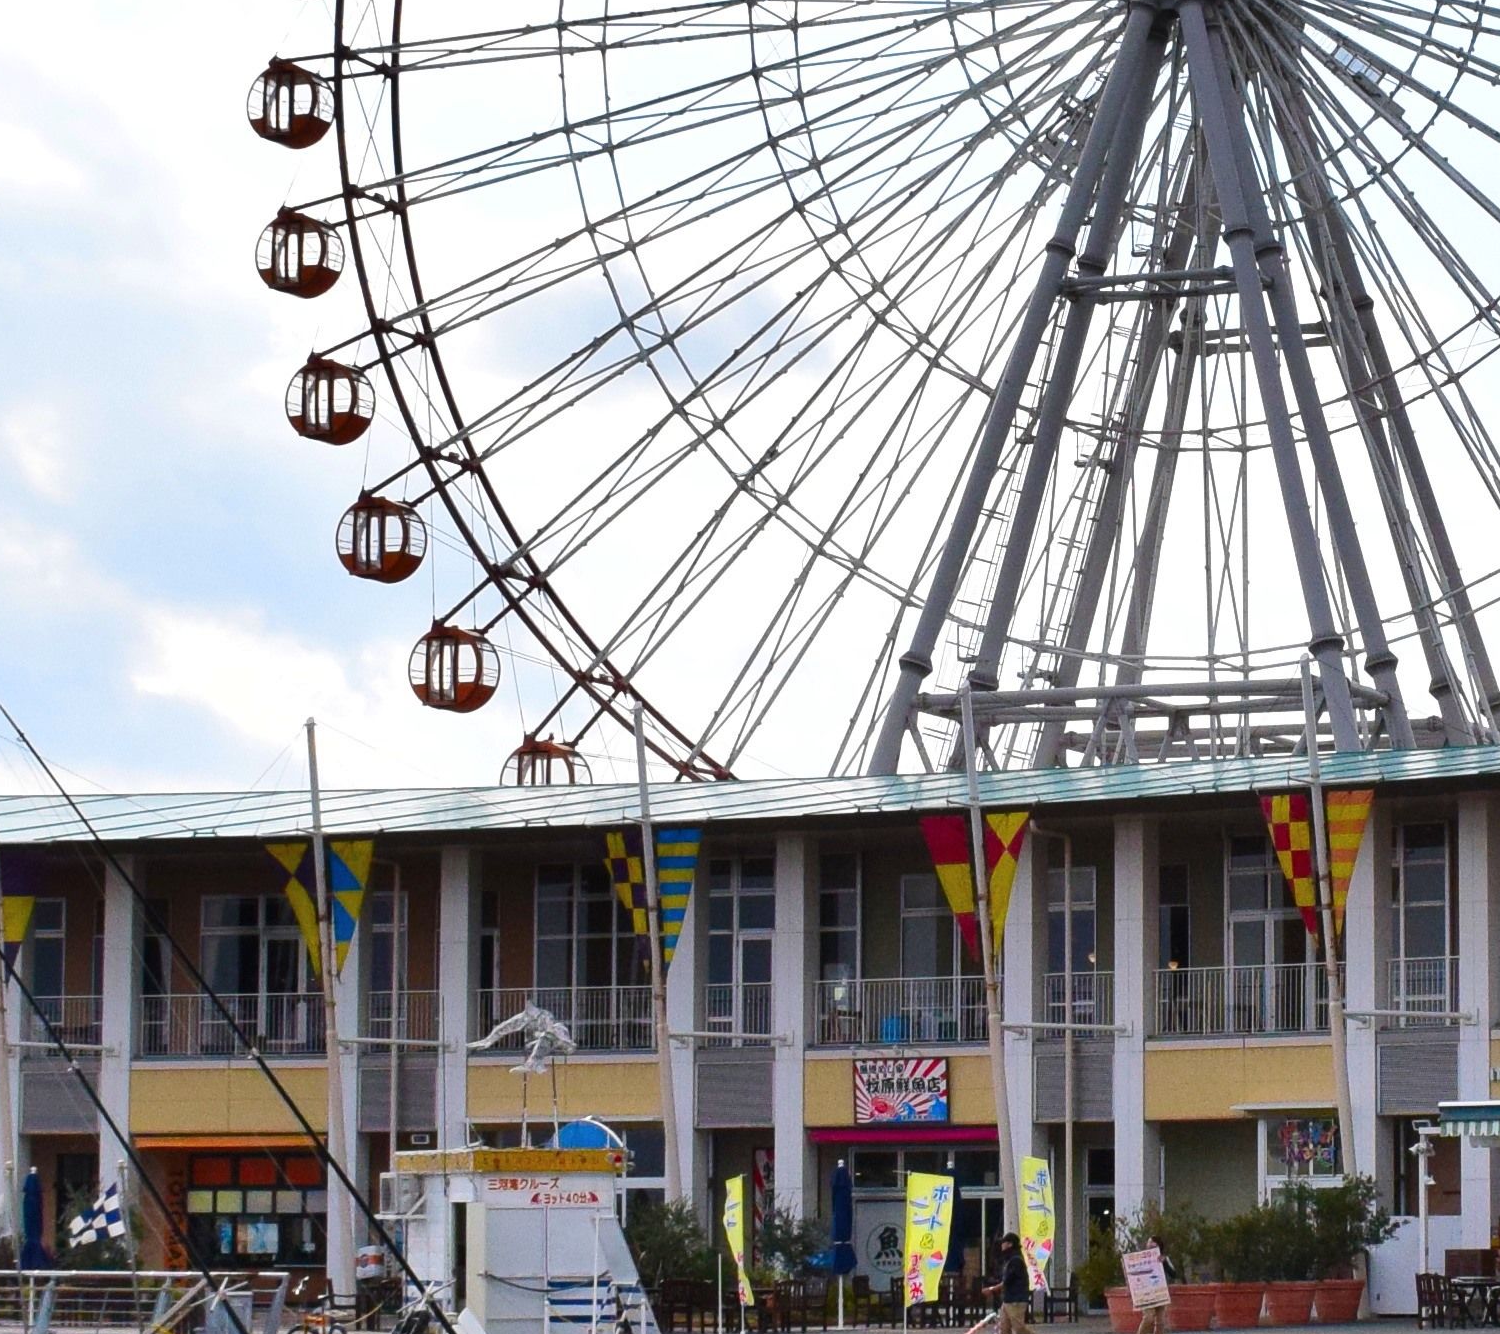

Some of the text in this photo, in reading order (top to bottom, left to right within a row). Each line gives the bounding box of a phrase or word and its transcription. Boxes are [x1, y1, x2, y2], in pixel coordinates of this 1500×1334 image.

[488, 1177, 560, 1191] 三河湾クルーズ
[543, 1193, 588, 1204] ヨット40分
